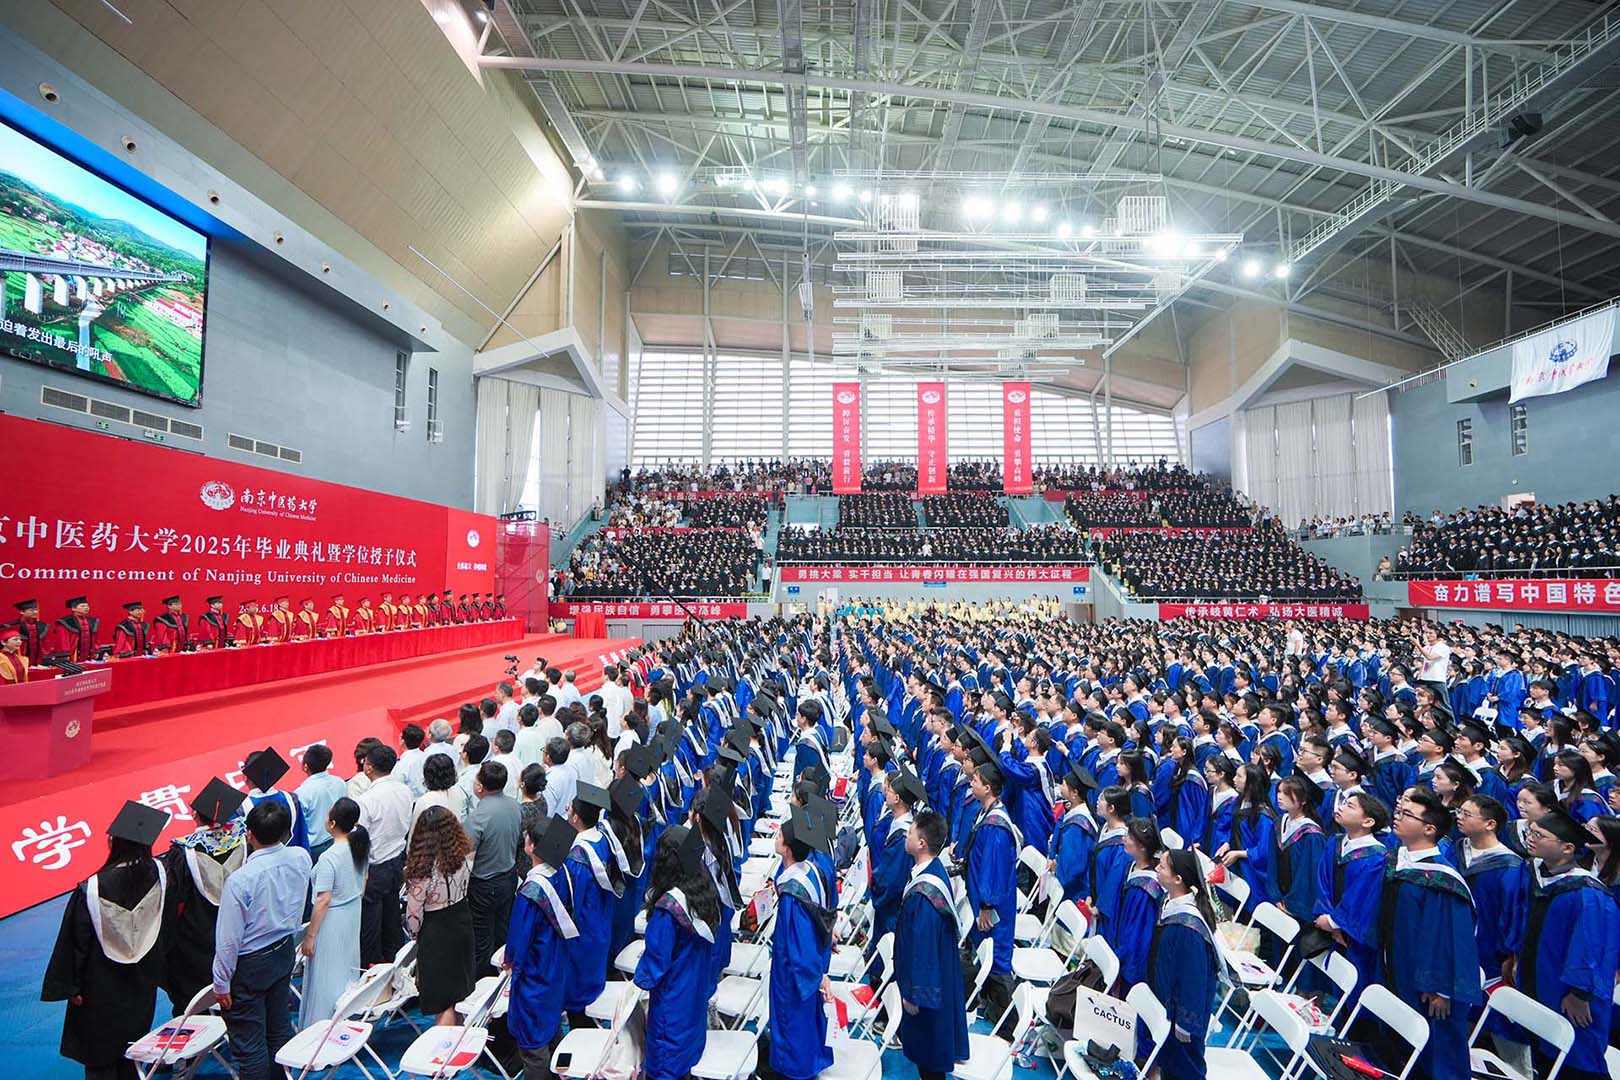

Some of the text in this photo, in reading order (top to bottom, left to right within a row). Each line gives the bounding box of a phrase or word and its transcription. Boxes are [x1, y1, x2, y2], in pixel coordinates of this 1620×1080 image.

[240, 488, 317, 513] 南京中医药大学
[0, 562, 416, 585] Commencement of Nanjing University of Chinese Medicine
[799, 569, 1072, 579] 勇挑大梁 实干担当 让青春闪耀在强国复兴的伟大征程
[1433, 582, 1620, 604] 奋力谱写中国特色
[569, 605, 640, 616] 增强民族自信
[1185, 607, 1343, 618] 传承岐黄仁术 弘扬大医精诚
[1093, 1006, 1131, 1030] CACTUS
